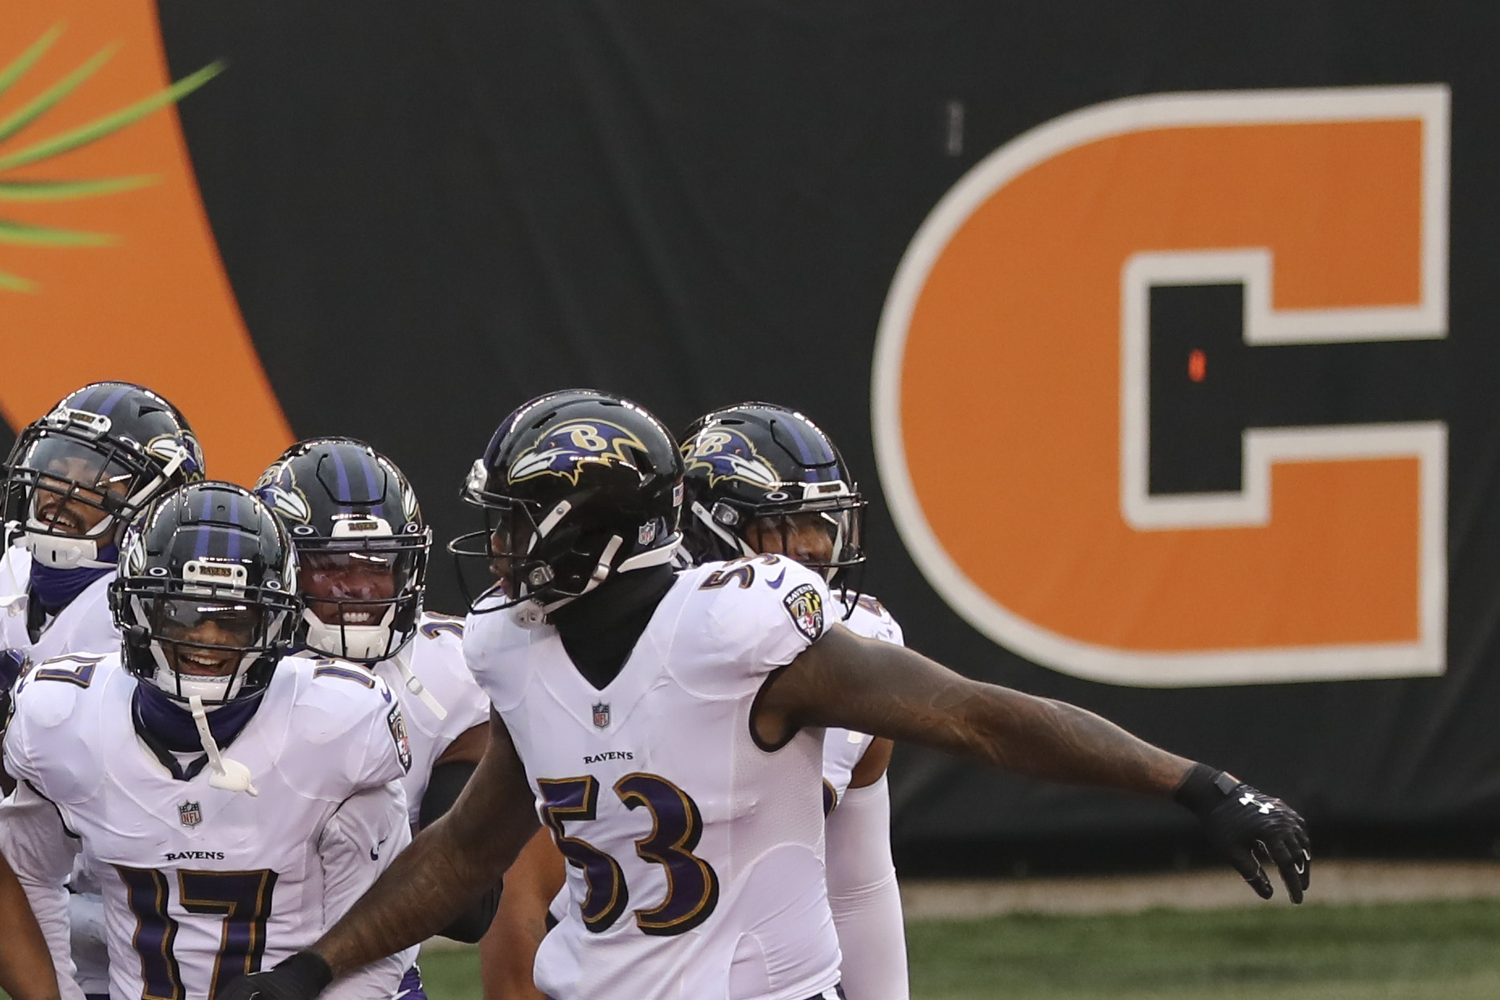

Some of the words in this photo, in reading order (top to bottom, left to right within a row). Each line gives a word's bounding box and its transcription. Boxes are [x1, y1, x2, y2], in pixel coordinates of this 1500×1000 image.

[552, 424, 608, 452] B
[695, 432, 733, 457] B
[583, 751, 634, 765] RAVENS
[182, 812, 200, 825] NFL
[165, 851, 225, 861] RAVENS
[536, 771, 720, 937] 53
